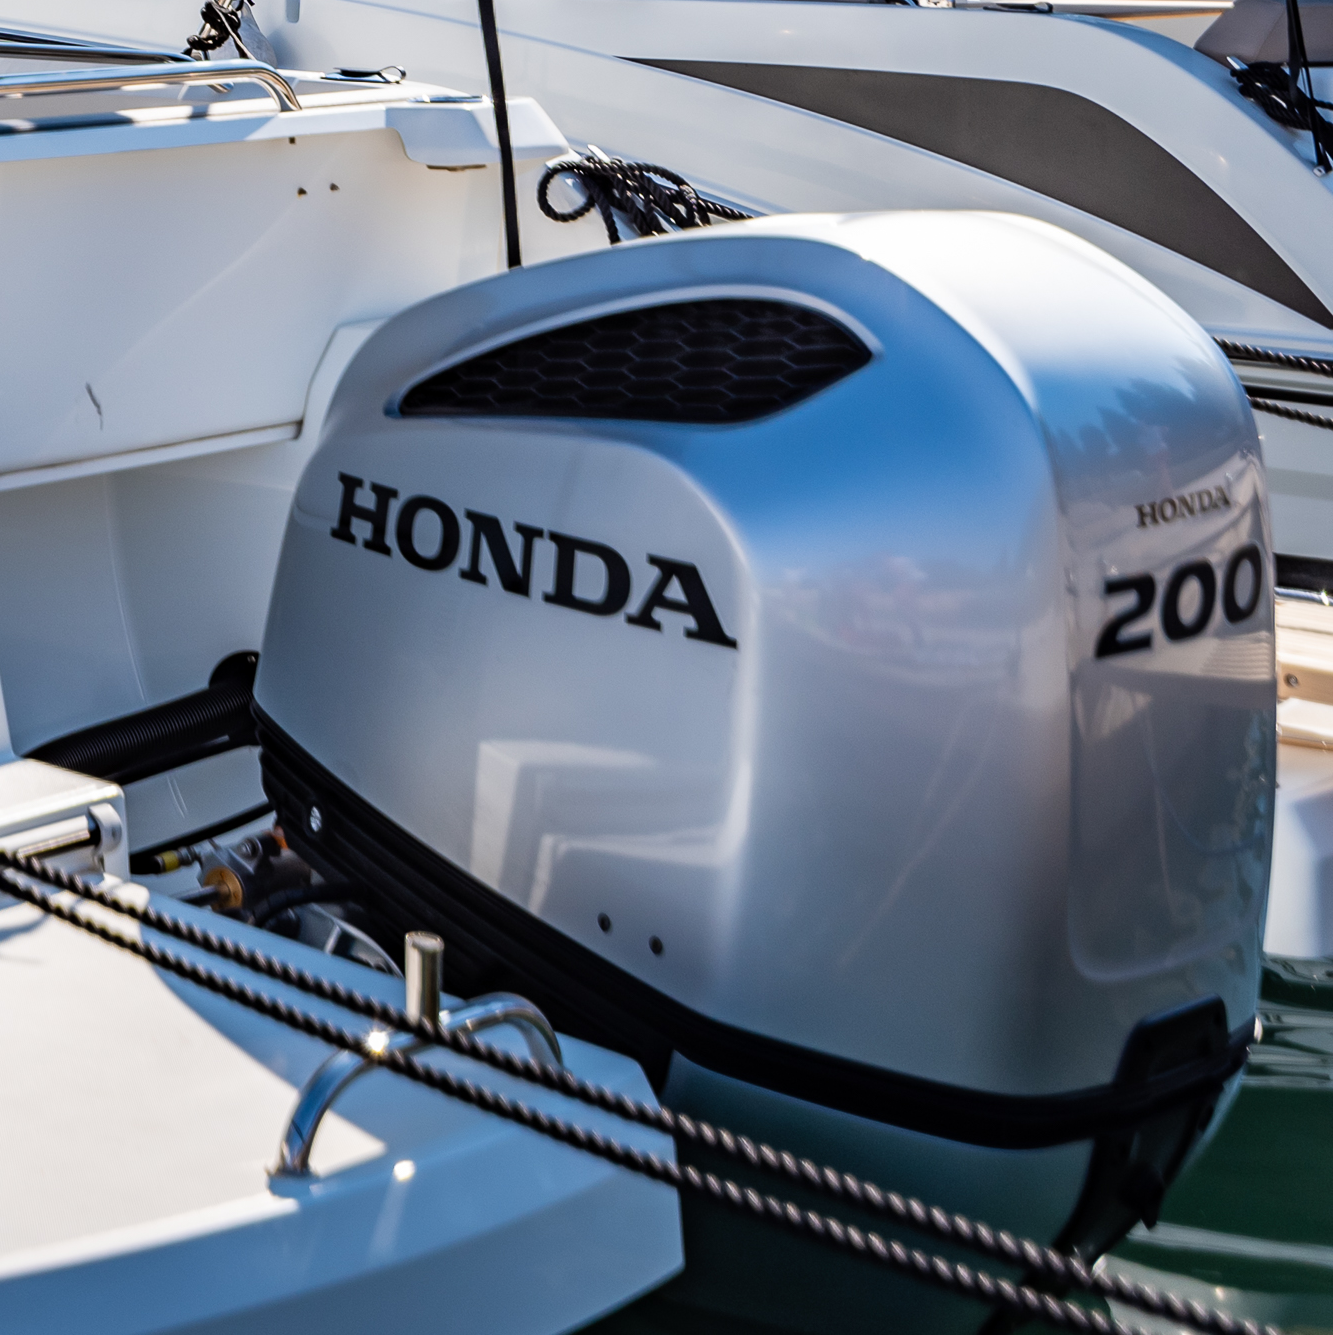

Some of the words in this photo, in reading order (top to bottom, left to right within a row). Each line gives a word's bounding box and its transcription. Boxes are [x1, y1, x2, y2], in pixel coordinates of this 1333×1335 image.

[330, 471, 738, 650] HONDA
[1133, 485, 1231, 529] HONDA
[1094, 542, 1263, 658] 200
